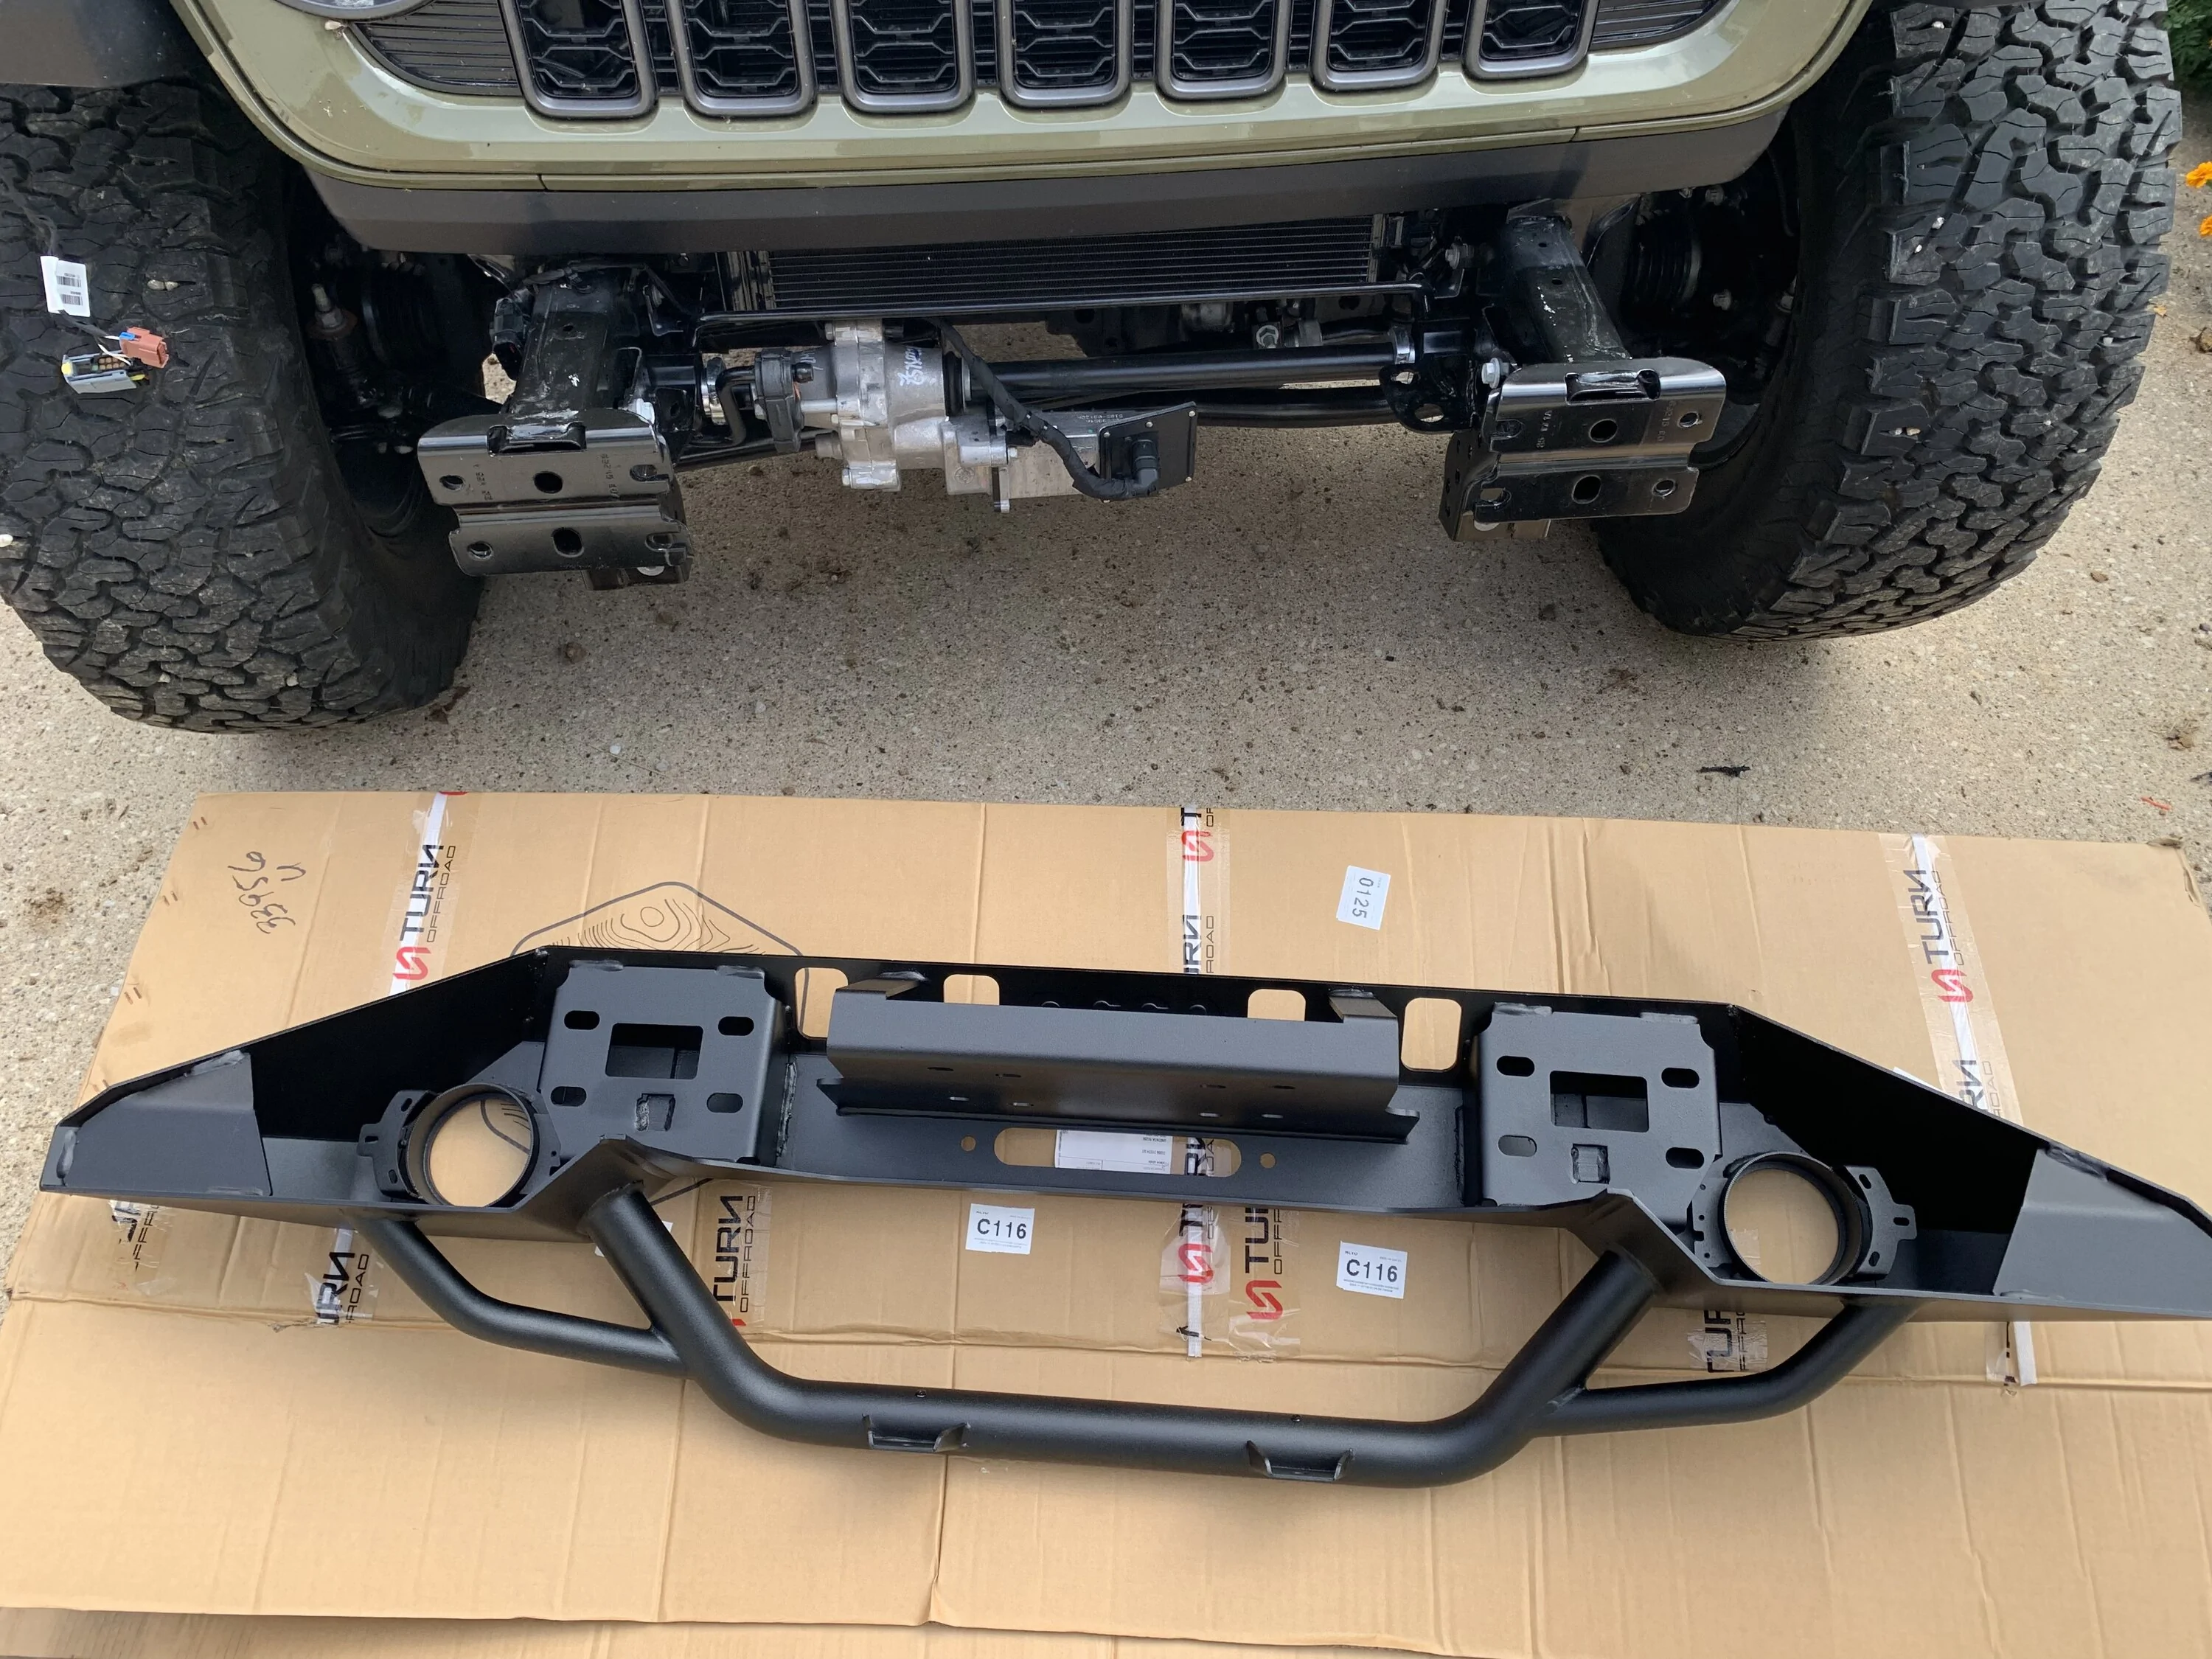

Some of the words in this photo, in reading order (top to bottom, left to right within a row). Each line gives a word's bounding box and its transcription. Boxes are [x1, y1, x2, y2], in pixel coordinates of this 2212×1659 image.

[426, 846, 456, 943] OFFROAD
[1352, 877, 1374, 919] 0125
[1931, 870, 1964, 966] OFFROAD
[1206, 915, 1214, 974] ROAD
[740, 1195, 756, 1312] OFFROAD
[976, 1217, 1027, 1239] C116
[346, 1253, 369, 1321] ROAD
[1346, 1259, 1399, 1283] C116
